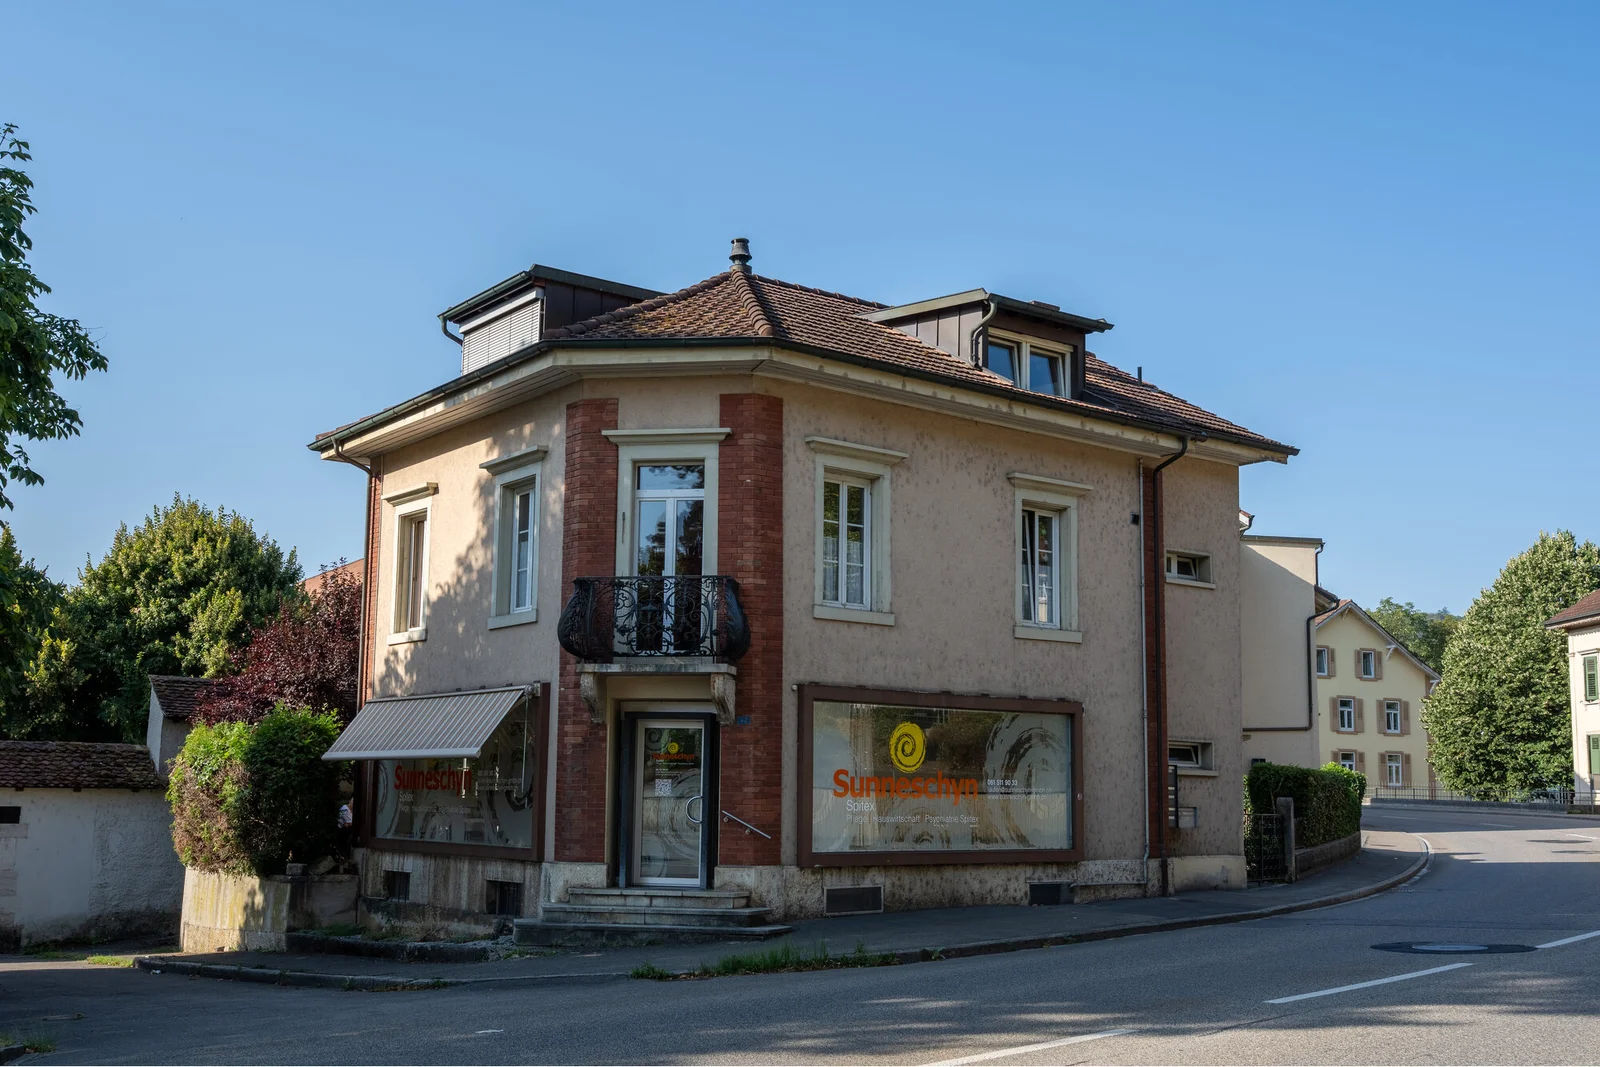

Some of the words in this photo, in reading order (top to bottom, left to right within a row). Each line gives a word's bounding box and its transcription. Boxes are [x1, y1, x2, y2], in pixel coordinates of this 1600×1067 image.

[394, 764, 472, 798] Sunneschyn
[833, 768, 979, 806] Sunneschyn
[846, 799, 875, 812] Spitex
[924, 814, 959, 826] Psychiatrie
[959, 814, 979, 826] Spitex
